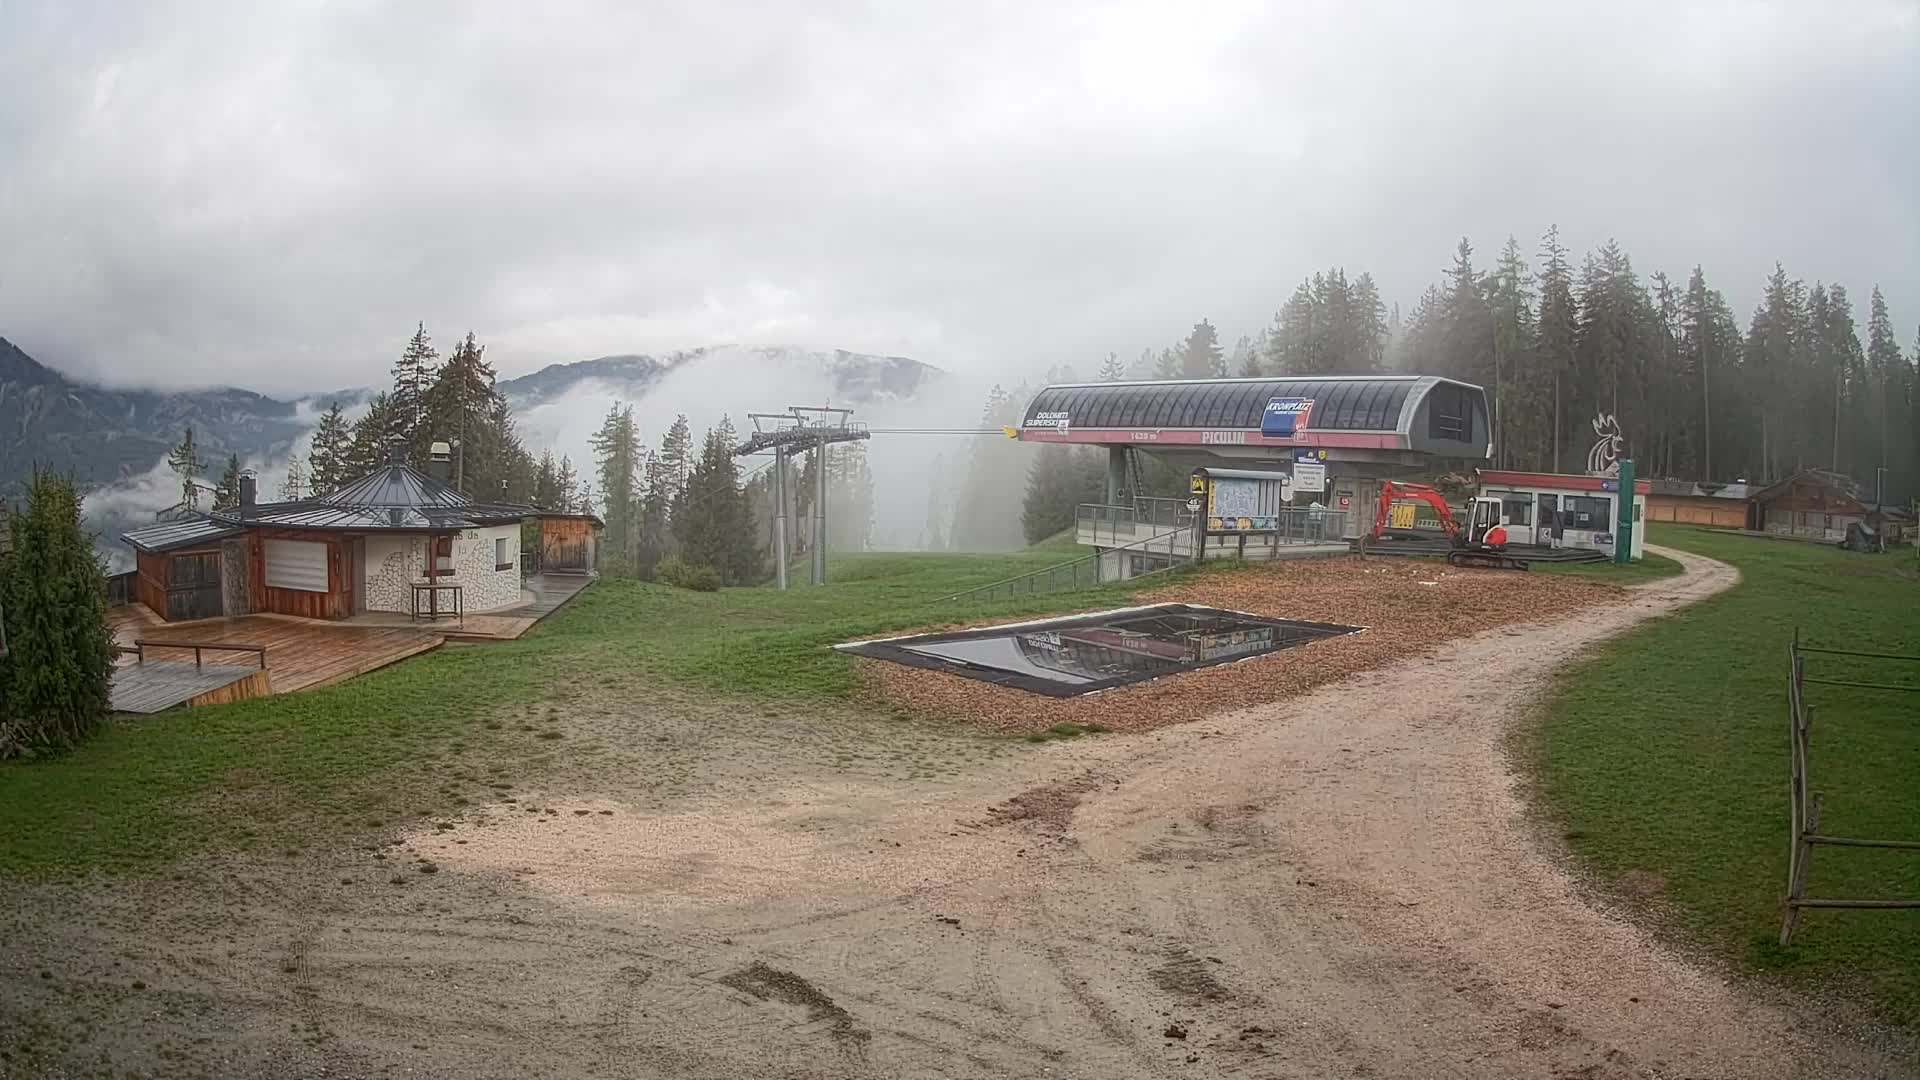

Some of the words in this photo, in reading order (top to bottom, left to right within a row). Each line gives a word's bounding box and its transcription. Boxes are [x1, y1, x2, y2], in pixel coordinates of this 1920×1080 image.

[1266, 403, 1312, 411] KRONPLATZ
[1036, 411, 1069, 419] DOLOMITI
[1202, 431, 1245, 444] PICULIN
